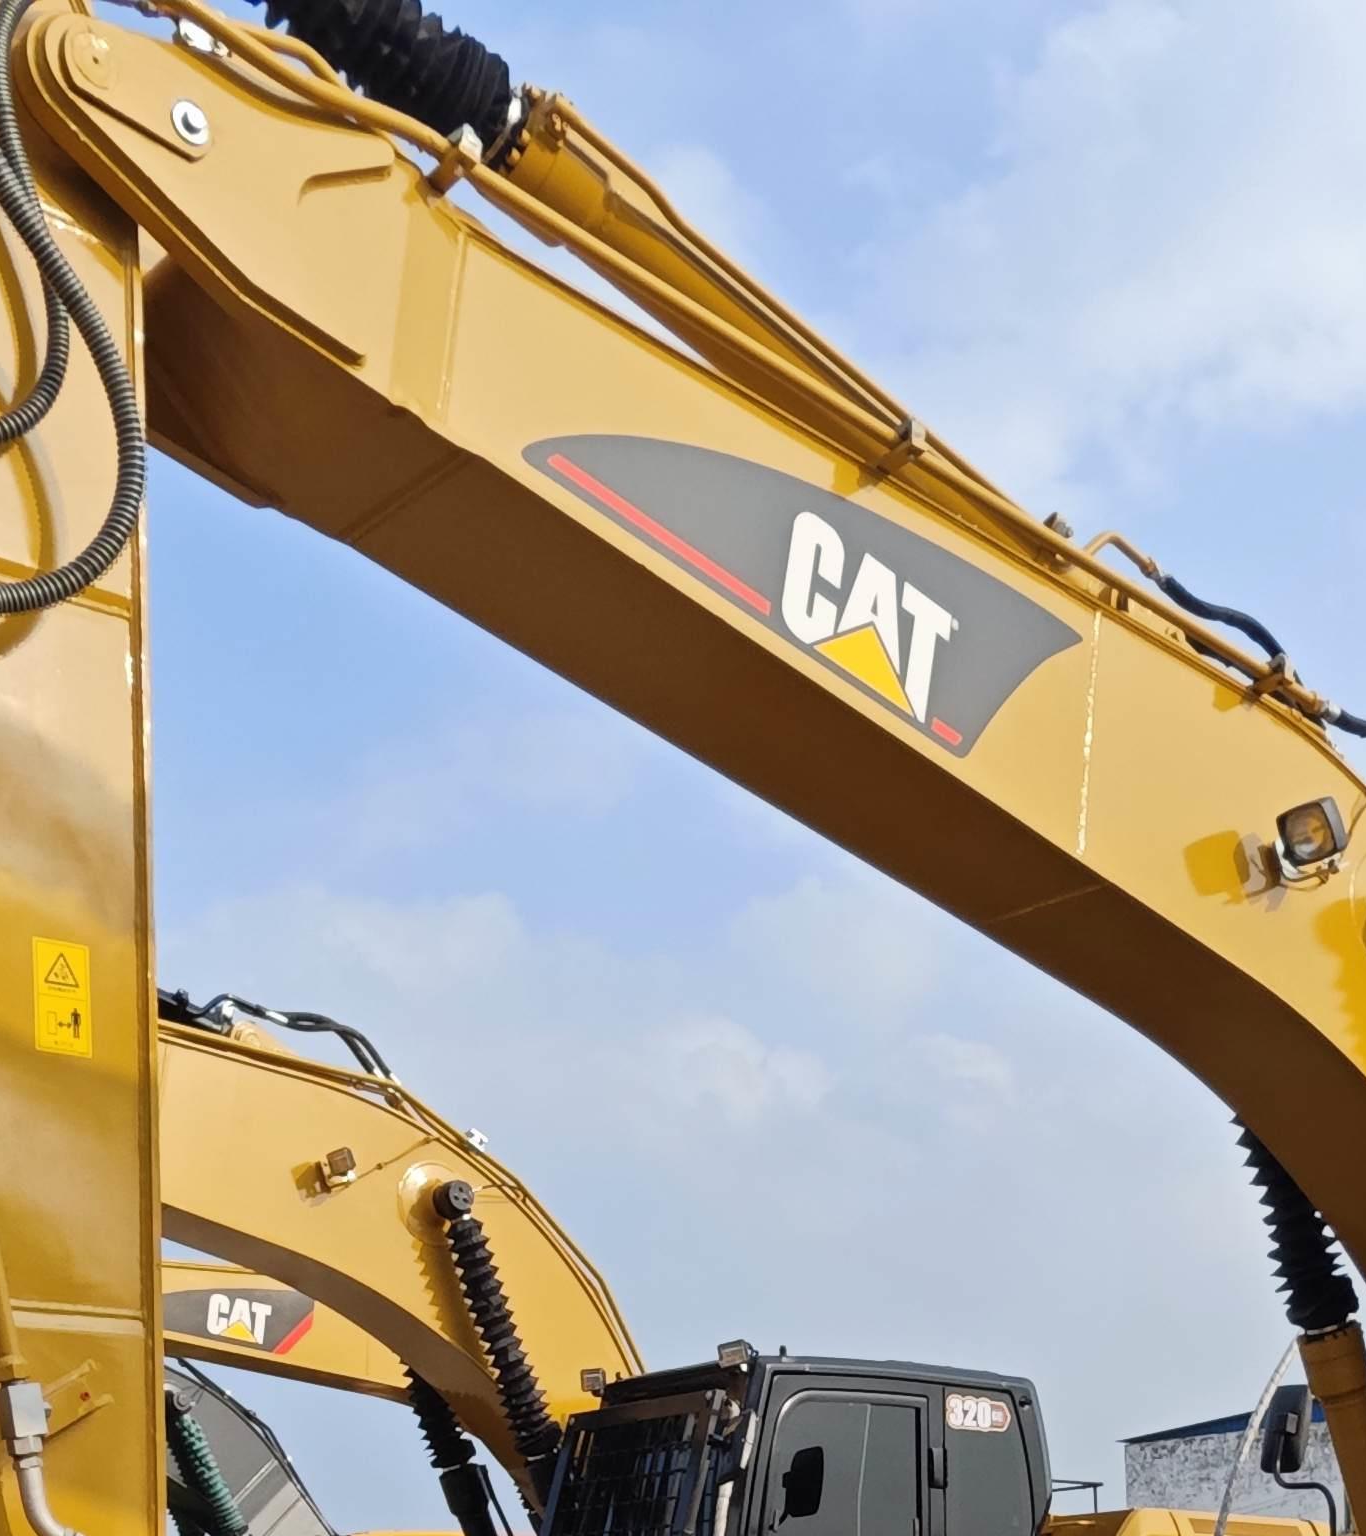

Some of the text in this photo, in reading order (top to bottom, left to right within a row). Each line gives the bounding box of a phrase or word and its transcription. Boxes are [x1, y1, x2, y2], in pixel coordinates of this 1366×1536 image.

[782, 511, 954, 724] CAT
[207, 1293, 272, 1345] CAT
[949, 1398, 992, 1428] 320
